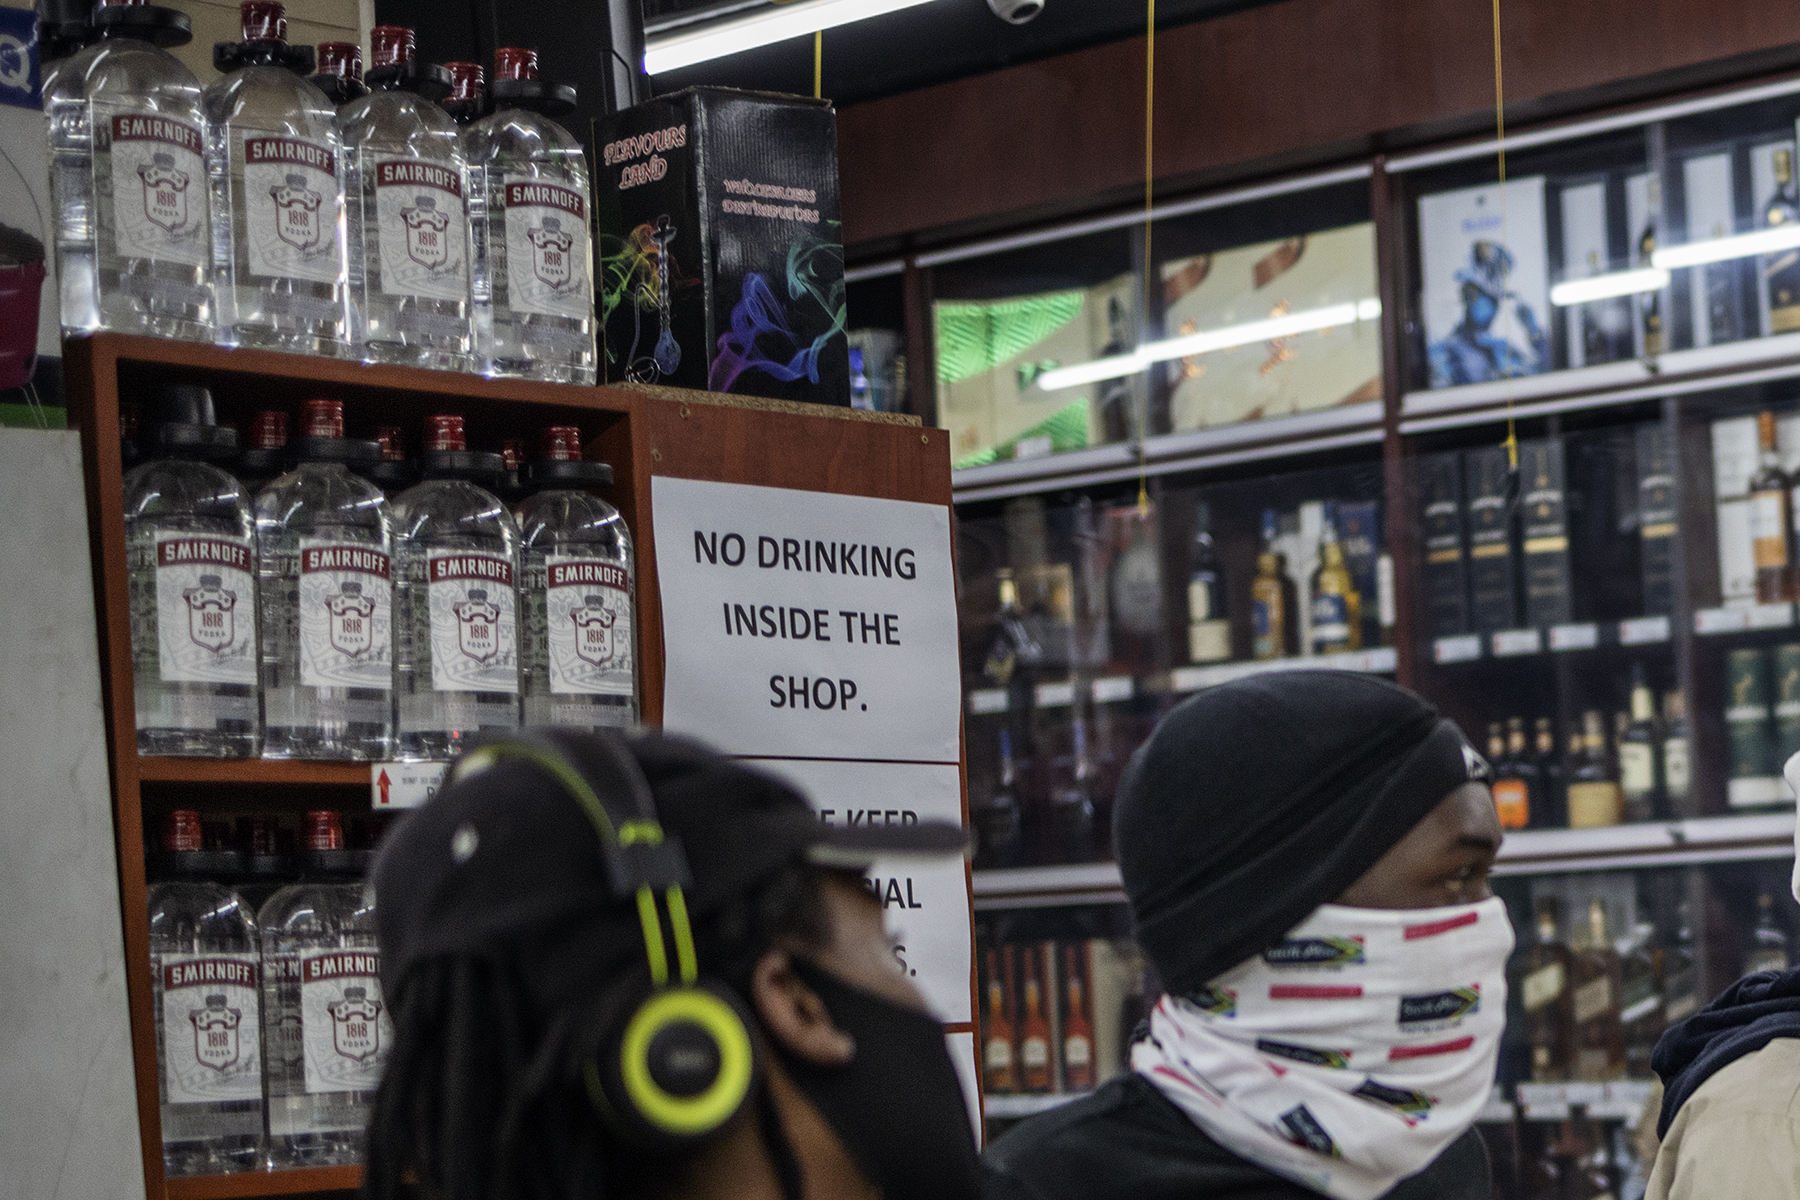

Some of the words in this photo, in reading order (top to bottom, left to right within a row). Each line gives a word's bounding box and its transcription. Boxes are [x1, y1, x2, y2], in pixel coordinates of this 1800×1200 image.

[603, 124, 687, 167] FLAVOURS
[619, 153, 667, 190] LAND
[512, 186, 580, 210] SMIRNOFF
[418, 231, 437, 245] 1818
[544, 251, 562, 265] 1818
[309, 552, 385, 573] SMIRNOFF
[693, 530, 746, 566] NO
[757, 535, 917, 580] DRINKING
[437, 558, 509, 580] SMIRNOFF
[555, 565, 624, 586] SMIRNOFF
[202, 612, 224, 628] 1818
[342, 618, 362, 633] 1818
[722, 602, 831, 637] INSIDE
[839, 610, 901, 646] THE
[470, 624, 489, 639] 1818
[586, 629, 605, 643] 1818
[769, 675, 868, 713] SHOP.
[310, 954, 380, 977] SMIRNO
[207, 1032, 228, 1048] 1818
[346, 1022, 368, 1038] 1818
